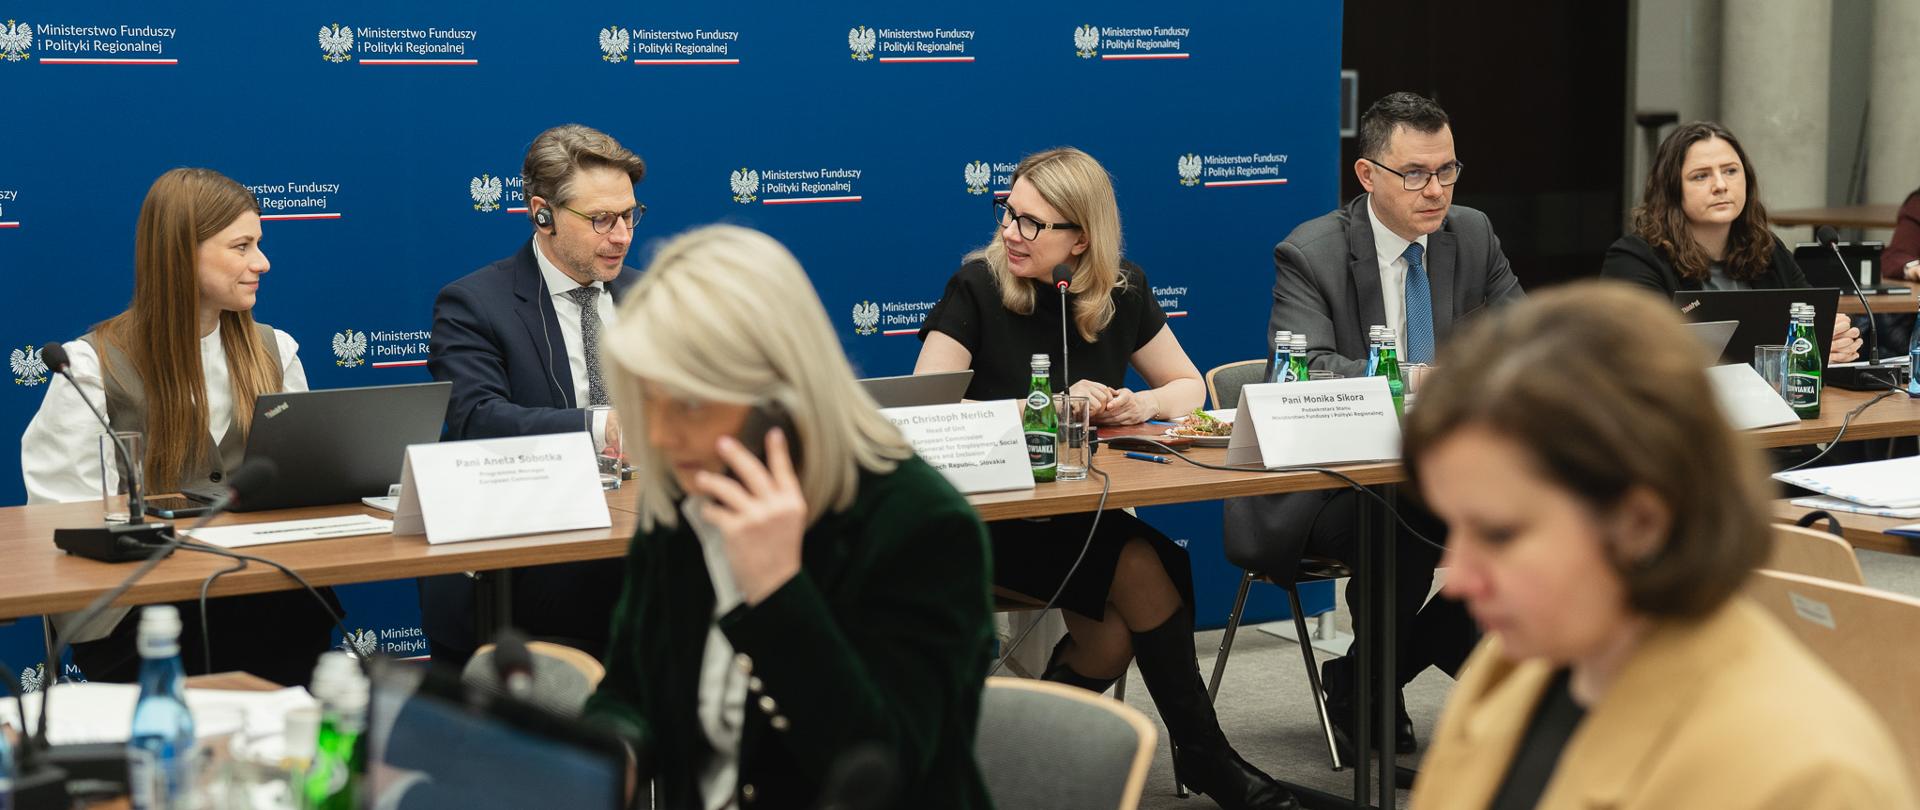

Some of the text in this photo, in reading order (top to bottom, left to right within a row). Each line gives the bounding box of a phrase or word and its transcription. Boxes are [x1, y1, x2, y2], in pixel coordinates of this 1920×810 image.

[37, 24, 176, 39] Ministerstwo Funduszy
[357, 27, 476, 41] Ministerstwo Funduszy
[633, 29, 739, 42] Ministerstwo Funduszy
[879, 28, 975, 40] Ministerstwo Funduszy
[1102, 26, 1190, 37] Ministerstwo Funduszy
[45, 40, 90, 53] Polityki
[94, 40, 162, 54] Regionalnej
[364, 42, 403, 54] Polityki
[406, 42, 465, 55] Regionalnej
[639, 43, 672, 55] Polityki
[675, 43, 728, 55] Regionalnej
[884, 41, 915, 53] Polityki
[917, 41, 965, 53] Regionalnej
[1106, 39, 1135, 50] Polityki
[1136, 39, 1180, 50] Regionalnej
[1204, 153, 1288, 165] Ministerstwo Funduszy
[762, 168, 861, 180] Ministerstwo Funduszy
[1209, 166, 1235, 178] Polityki
[1237, 164, 1279, 177] Regionalnej
[288, 182, 341, 194] Funduszy
[767, 182, 799, 194] Polityki
[802, 180, 851, 193] Regionalnej
[263, 196, 327, 209] Regionalnej
[1152, 286, 1188, 296] Funduszy
[887, 314, 917, 326] Polityki
[371, 330, 432, 342] Ministerstw
[377, 343, 416, 356] Polityki
[1282, 393, 1364, 404] Pani Monika Sikora
[890, 410, 994, 427] Pan Christoph Nerlich
[999, 438, 1018, 446] Social
[456, 453, 562, 467] Pani Aneta Sobotka
[388, 639, 426, 654] Polityki
